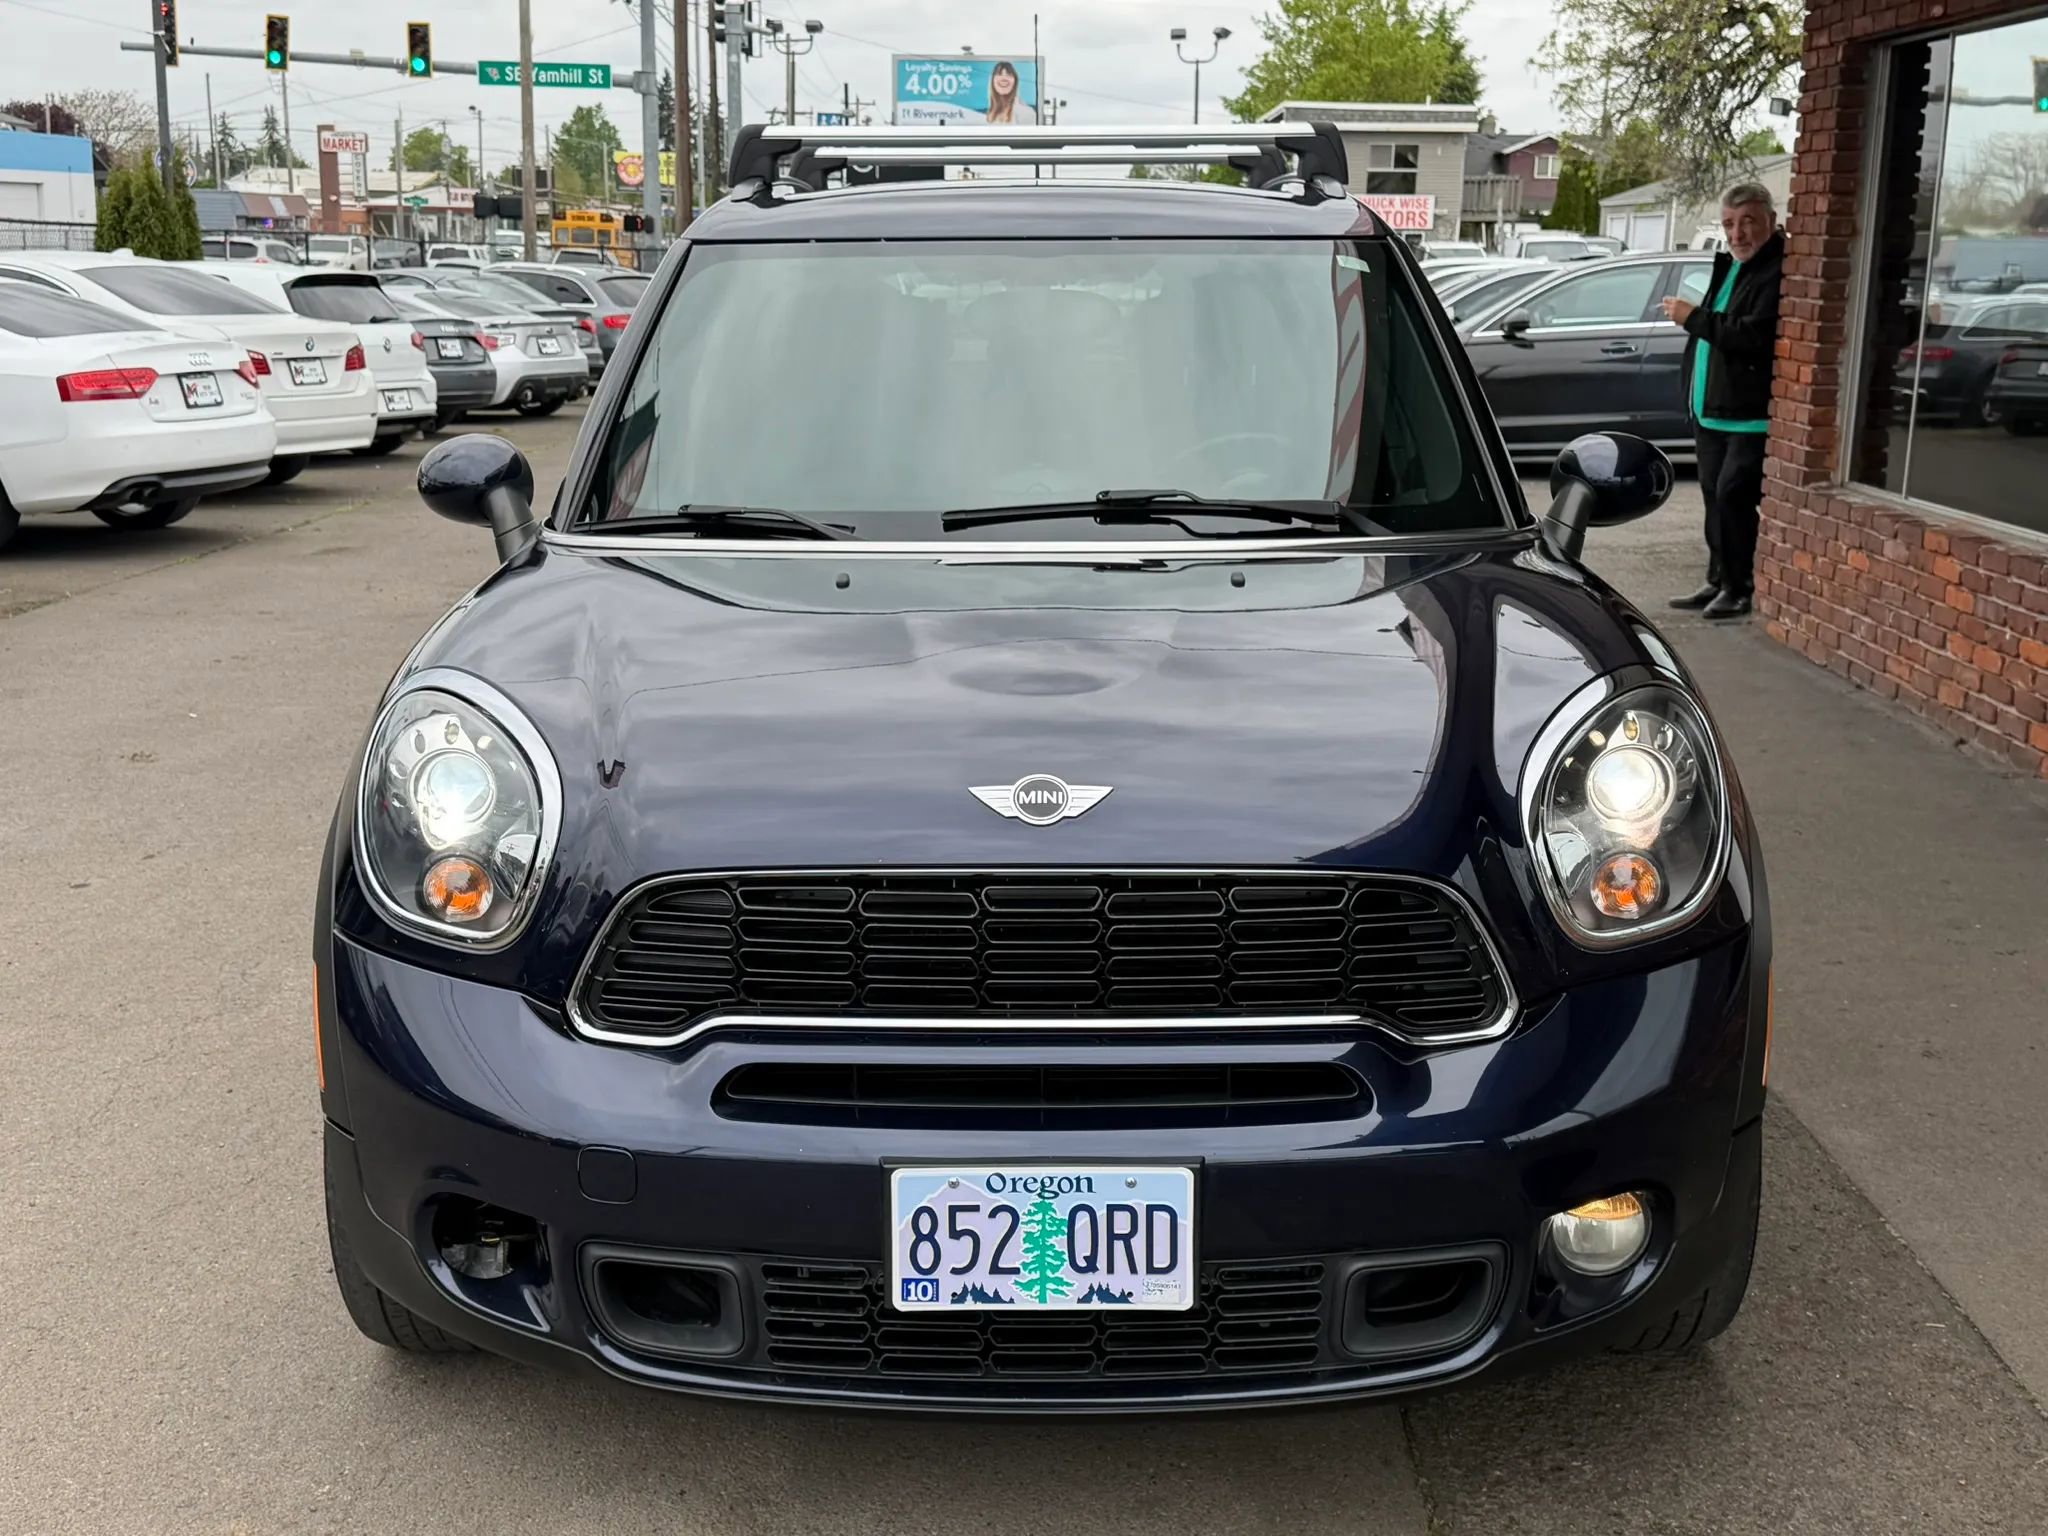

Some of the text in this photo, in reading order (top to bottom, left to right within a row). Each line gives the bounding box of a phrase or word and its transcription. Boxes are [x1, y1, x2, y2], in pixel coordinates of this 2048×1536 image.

[504, 65, 604, 84] SE Yamhill St
[912, 108, 965, 119] Rivermark
[322, 137, 365, 152] MARKET
[1400, 197, 1430, 209] WISE
[1376, 210, 1428, 228] TORS
[1018, 789, 1063, 805] MINI
[985, 1172, 1097, 1200] Oregon
[908, 1202, 1179, 1276] 852 QRD
[907, 1281, 933, 1301] 10
